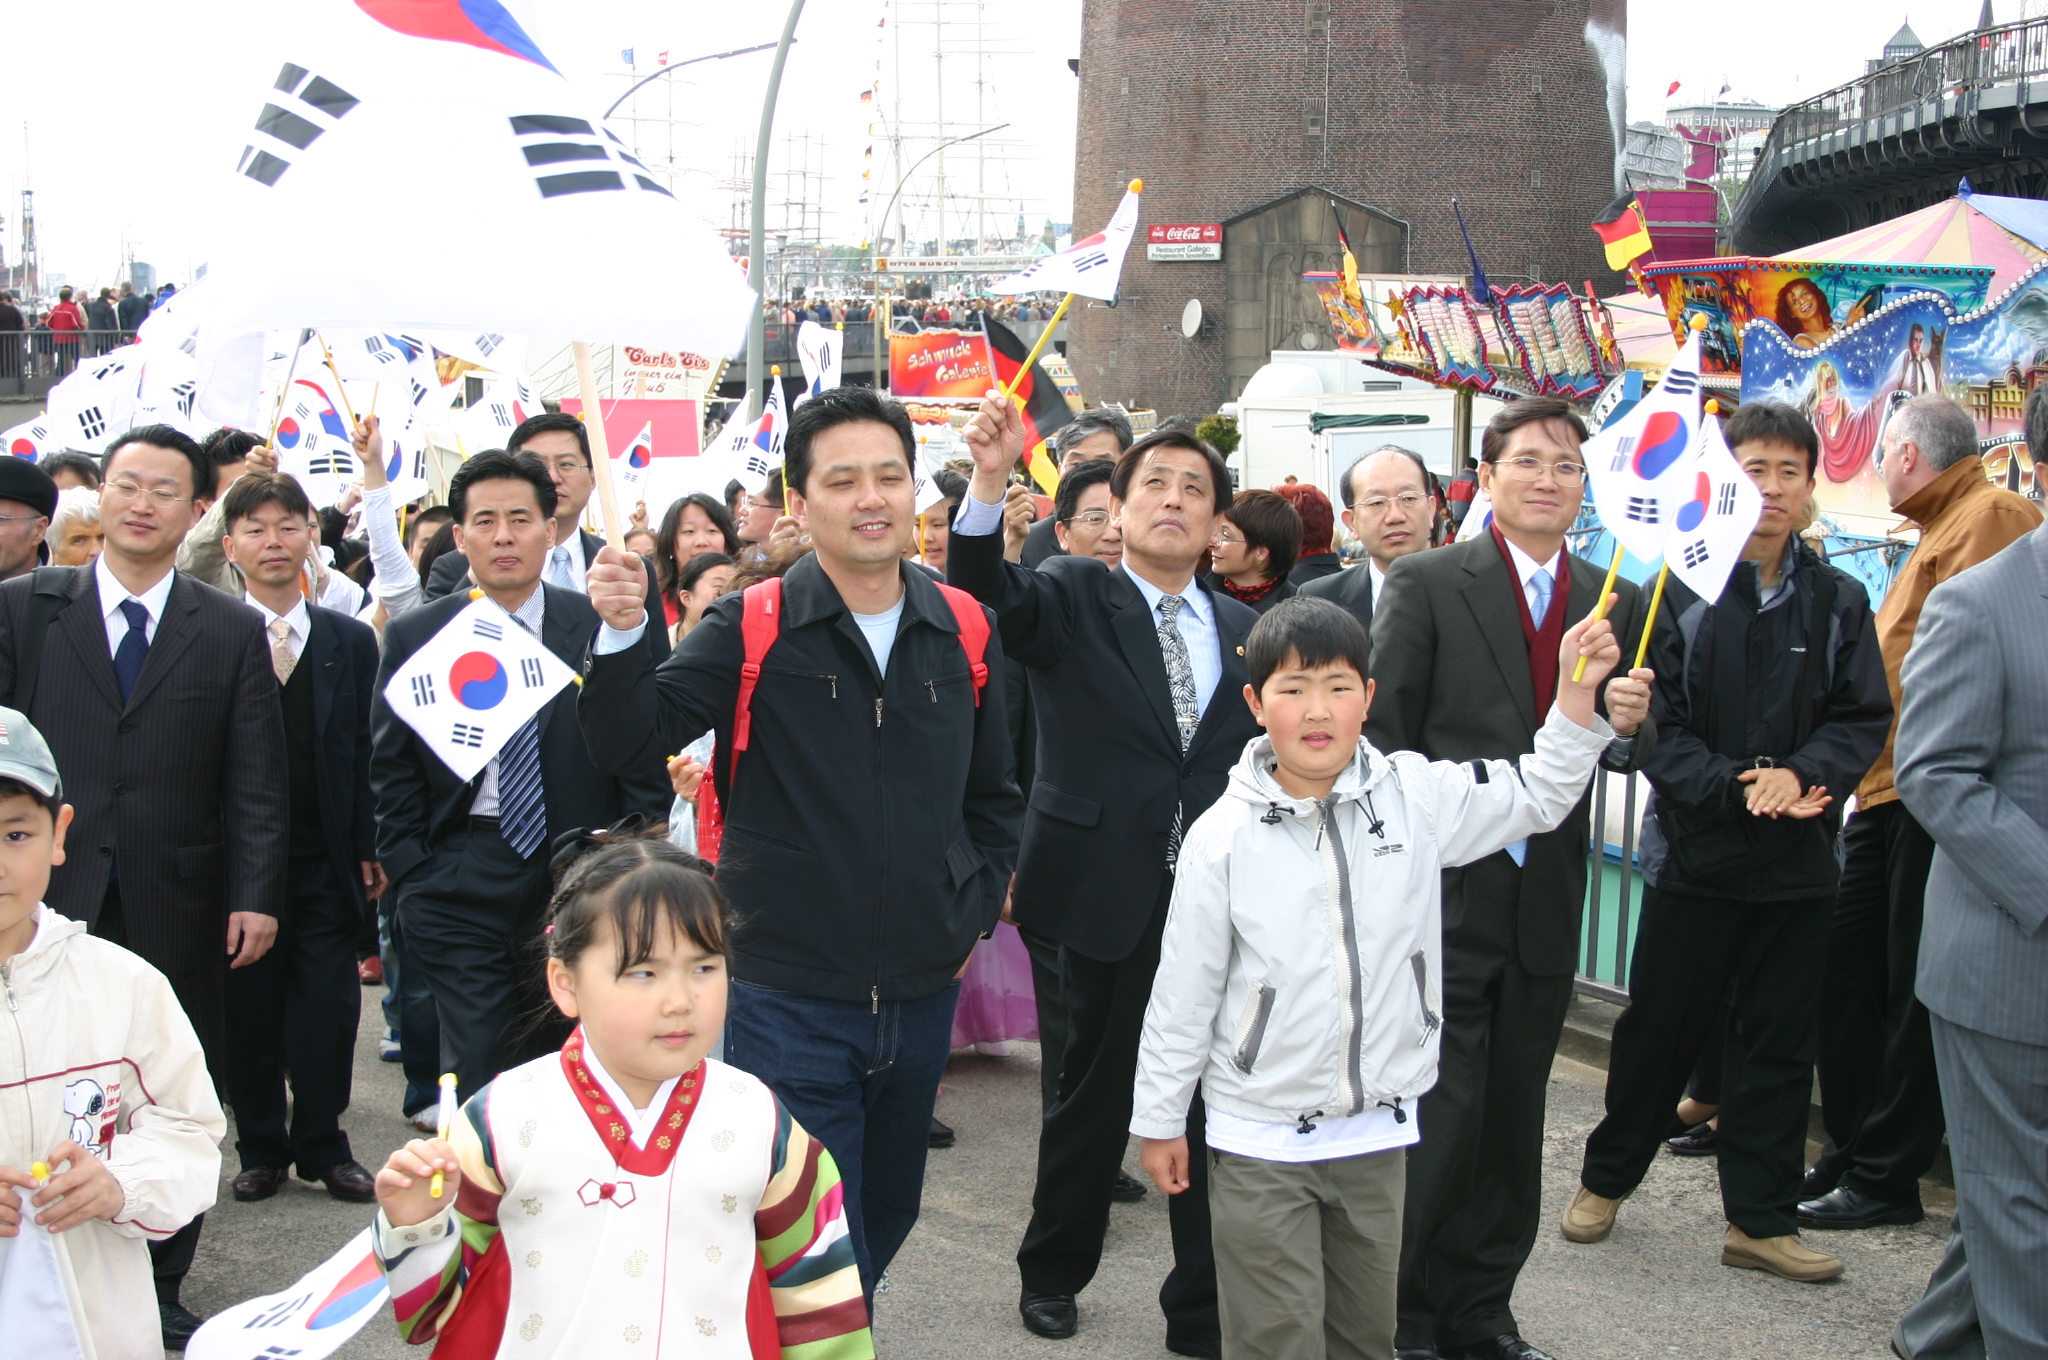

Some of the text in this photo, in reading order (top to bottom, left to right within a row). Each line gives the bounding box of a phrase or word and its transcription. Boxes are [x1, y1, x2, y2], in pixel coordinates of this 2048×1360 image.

[1187, 245, 1211, 254] Galego
[625, 346, 710, 371] Carls Eis
[908, 340, 972, 370] Schmuck
[665, 370, 683, 381] ein
[935, 361, 989, 385] Galerie
